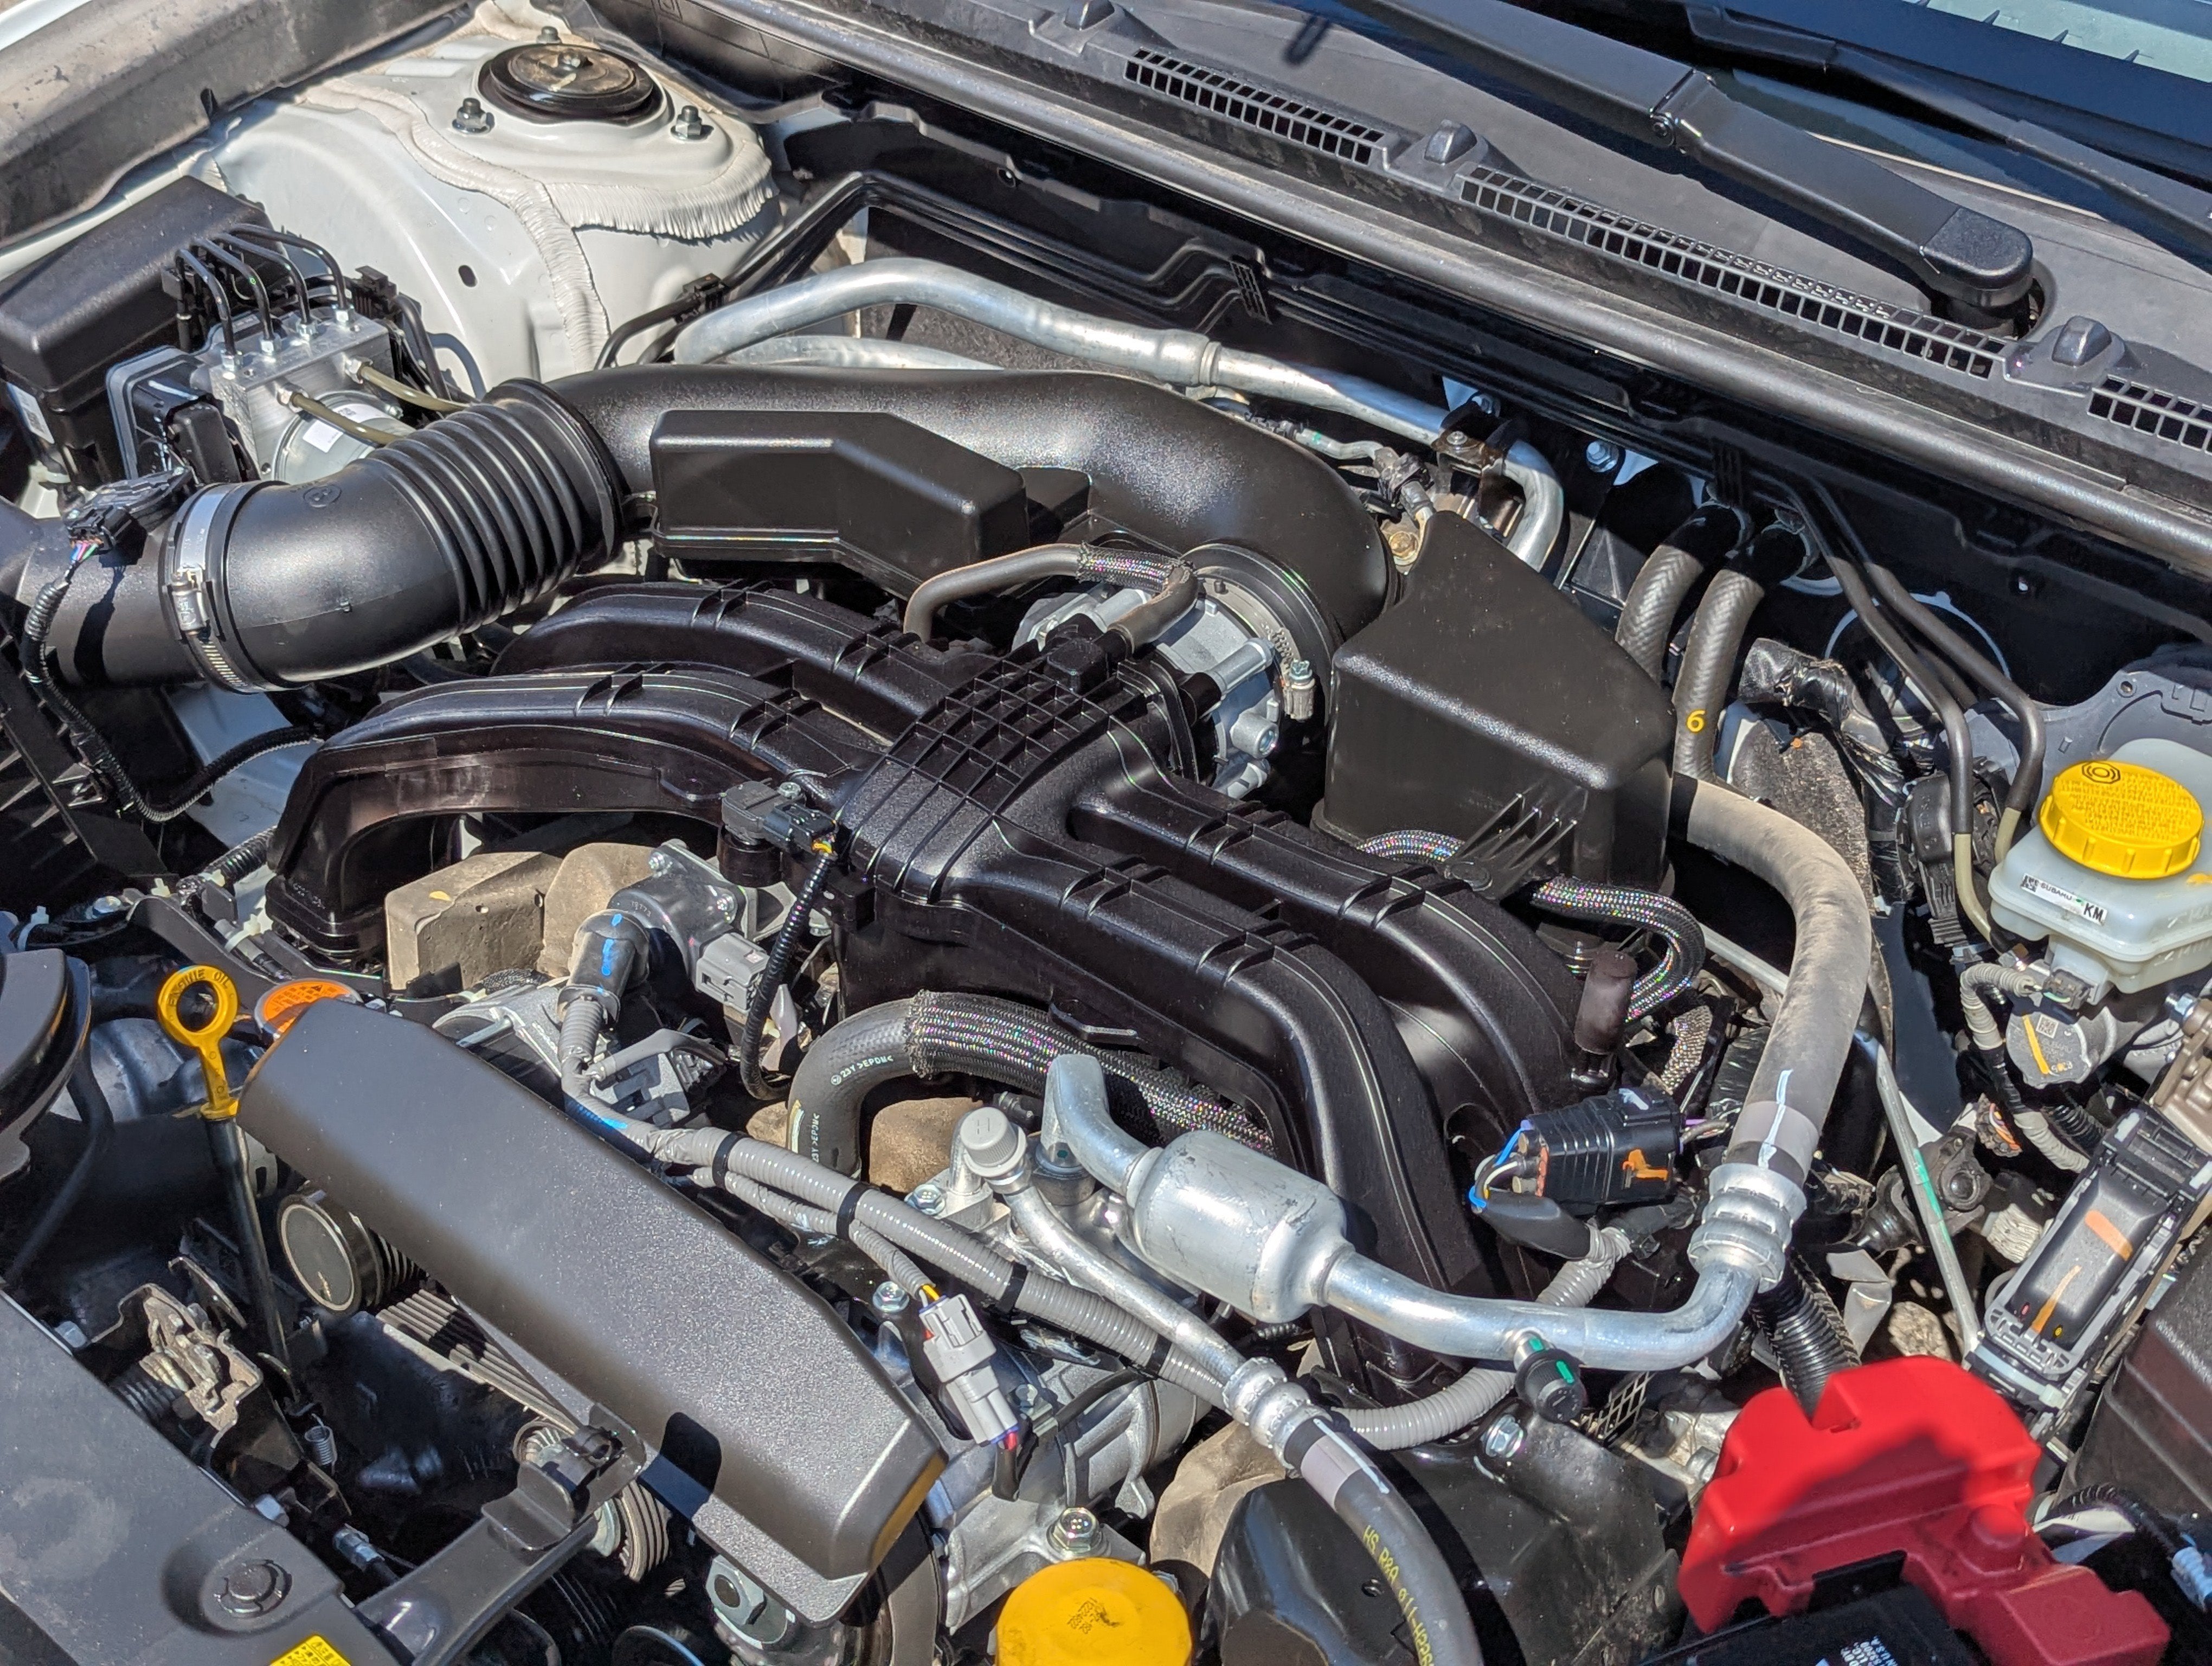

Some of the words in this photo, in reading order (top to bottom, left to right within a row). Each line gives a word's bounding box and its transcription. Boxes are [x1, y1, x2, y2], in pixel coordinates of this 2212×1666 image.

[1686, 709, 1706, 732] 6
[2084, 902, 2104, 922] KM
[168, 968, 205, 1007] ENGINE
[214, 971, 229, 989] OIL
[1363, 1524, 1379, 1554] HS
